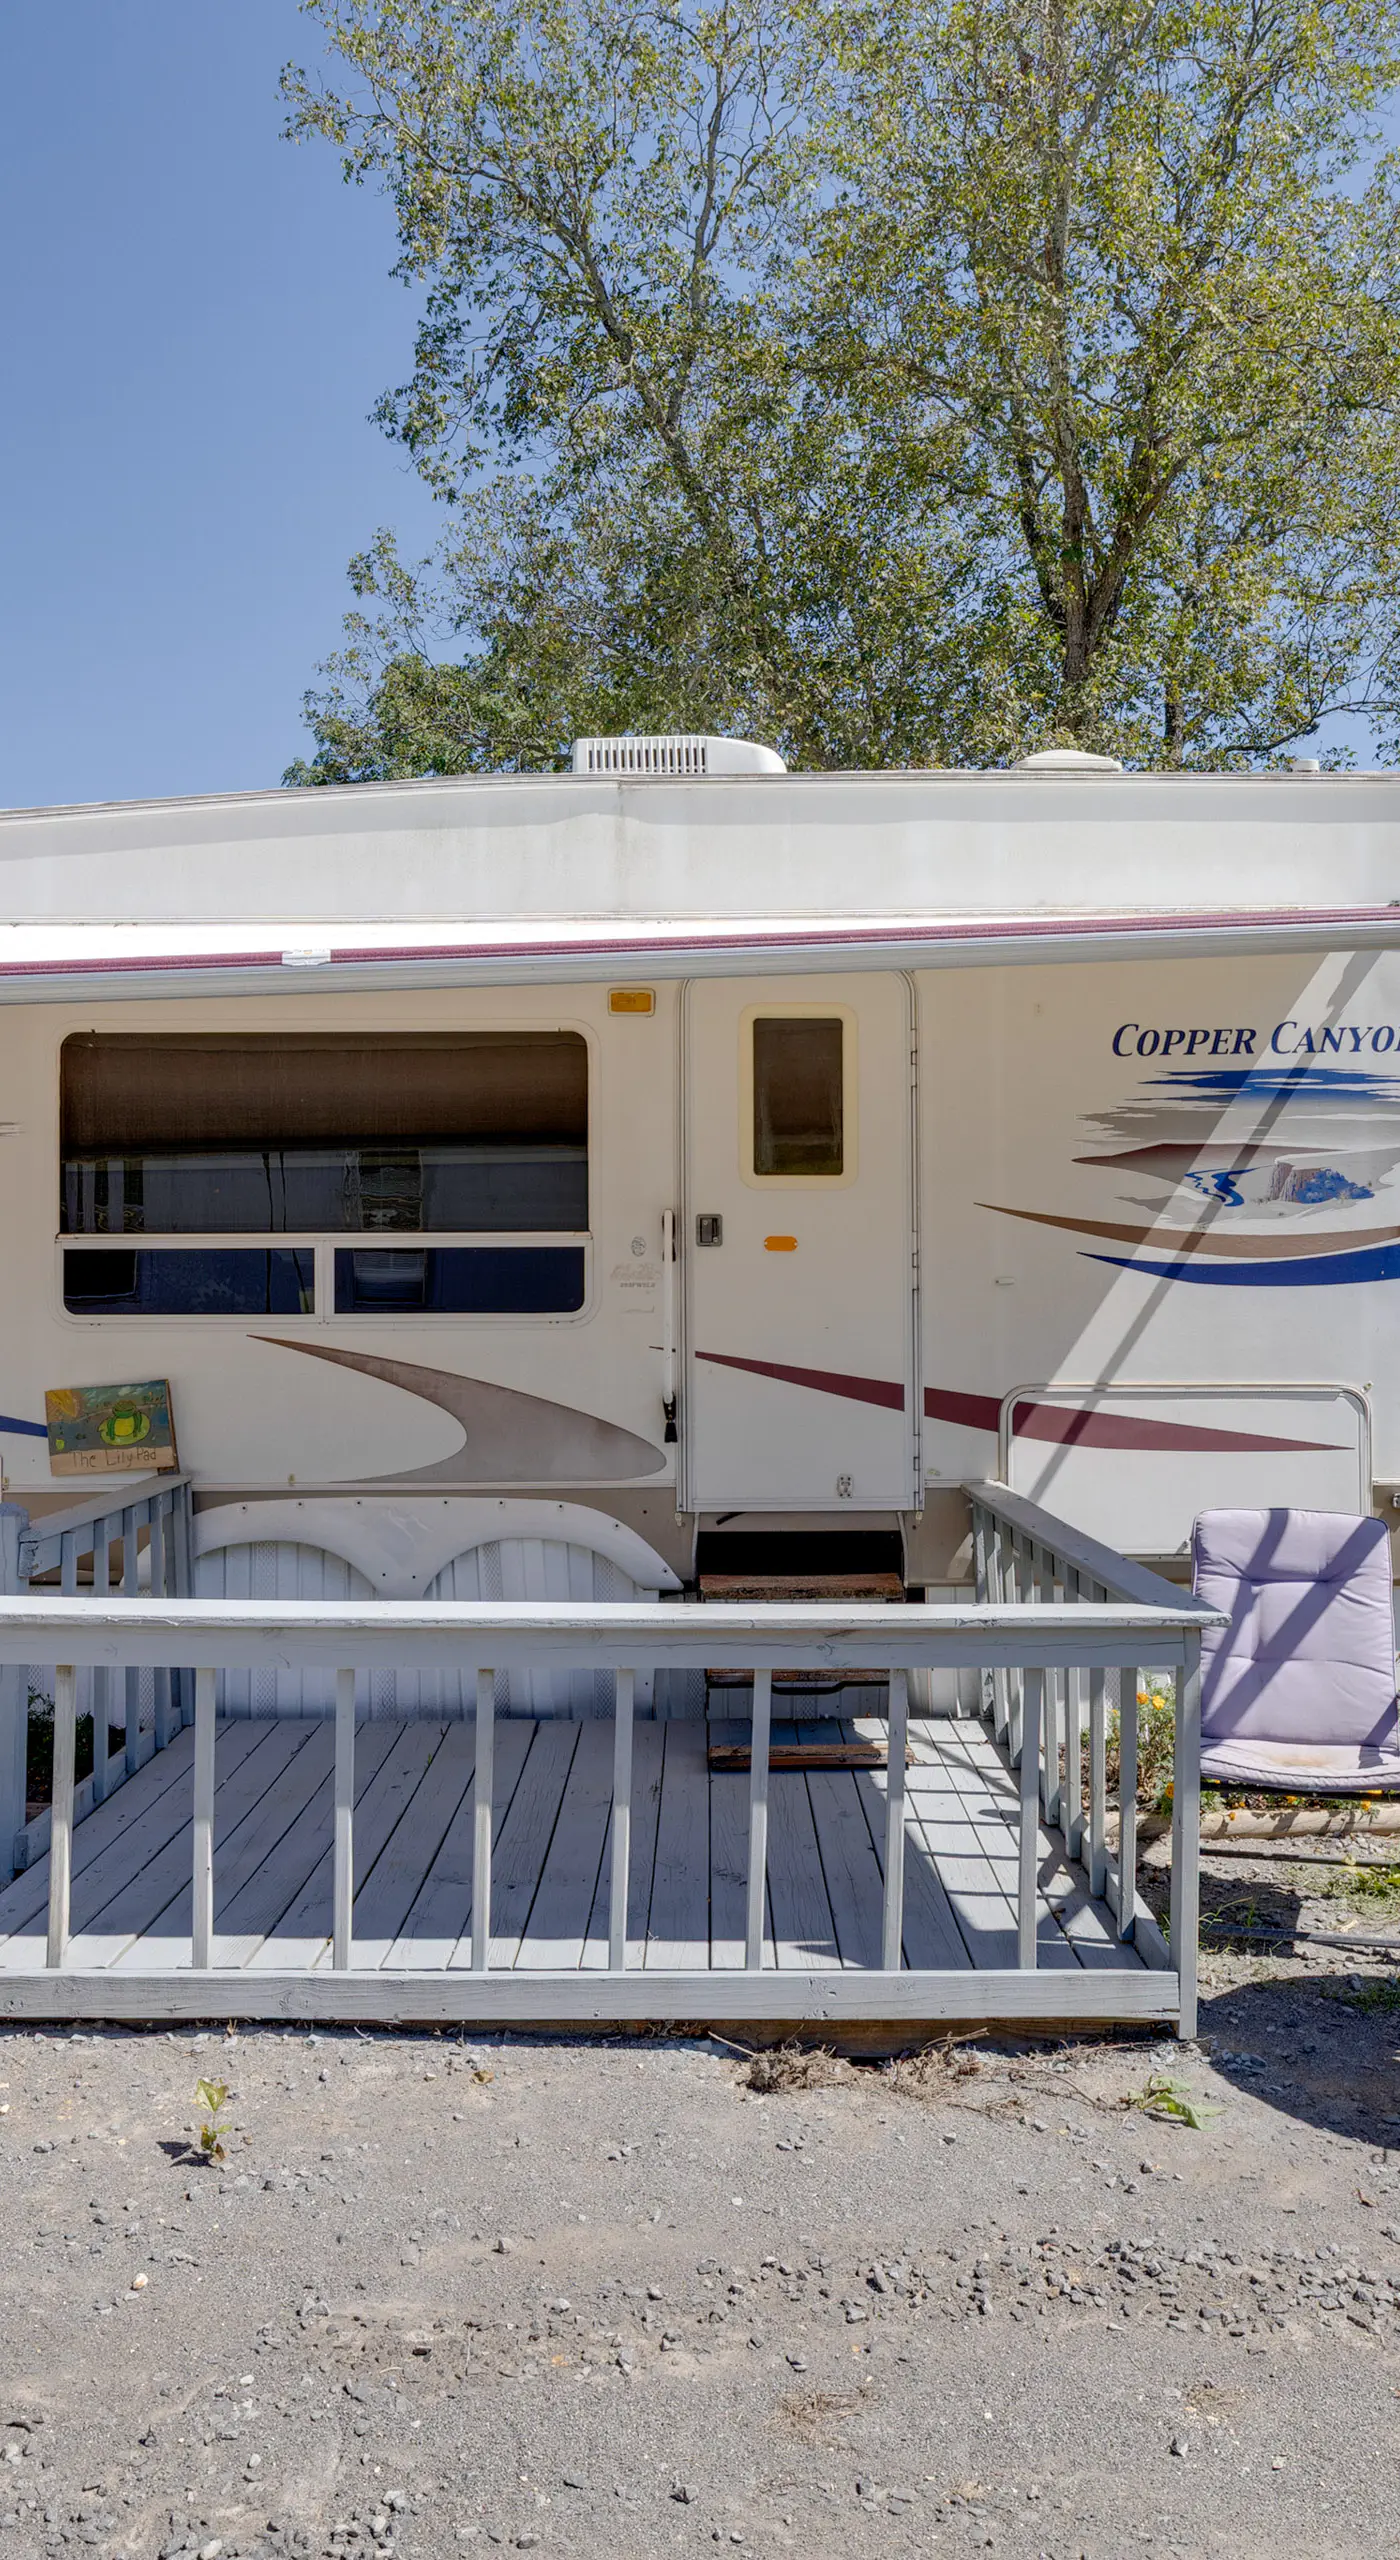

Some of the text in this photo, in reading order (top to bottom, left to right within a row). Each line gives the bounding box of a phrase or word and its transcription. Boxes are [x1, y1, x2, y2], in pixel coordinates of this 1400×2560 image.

[1111, 1021, 1400, 1057] COPPER CANYO
[70, 1447, 157, 1468] The Lily Pad
